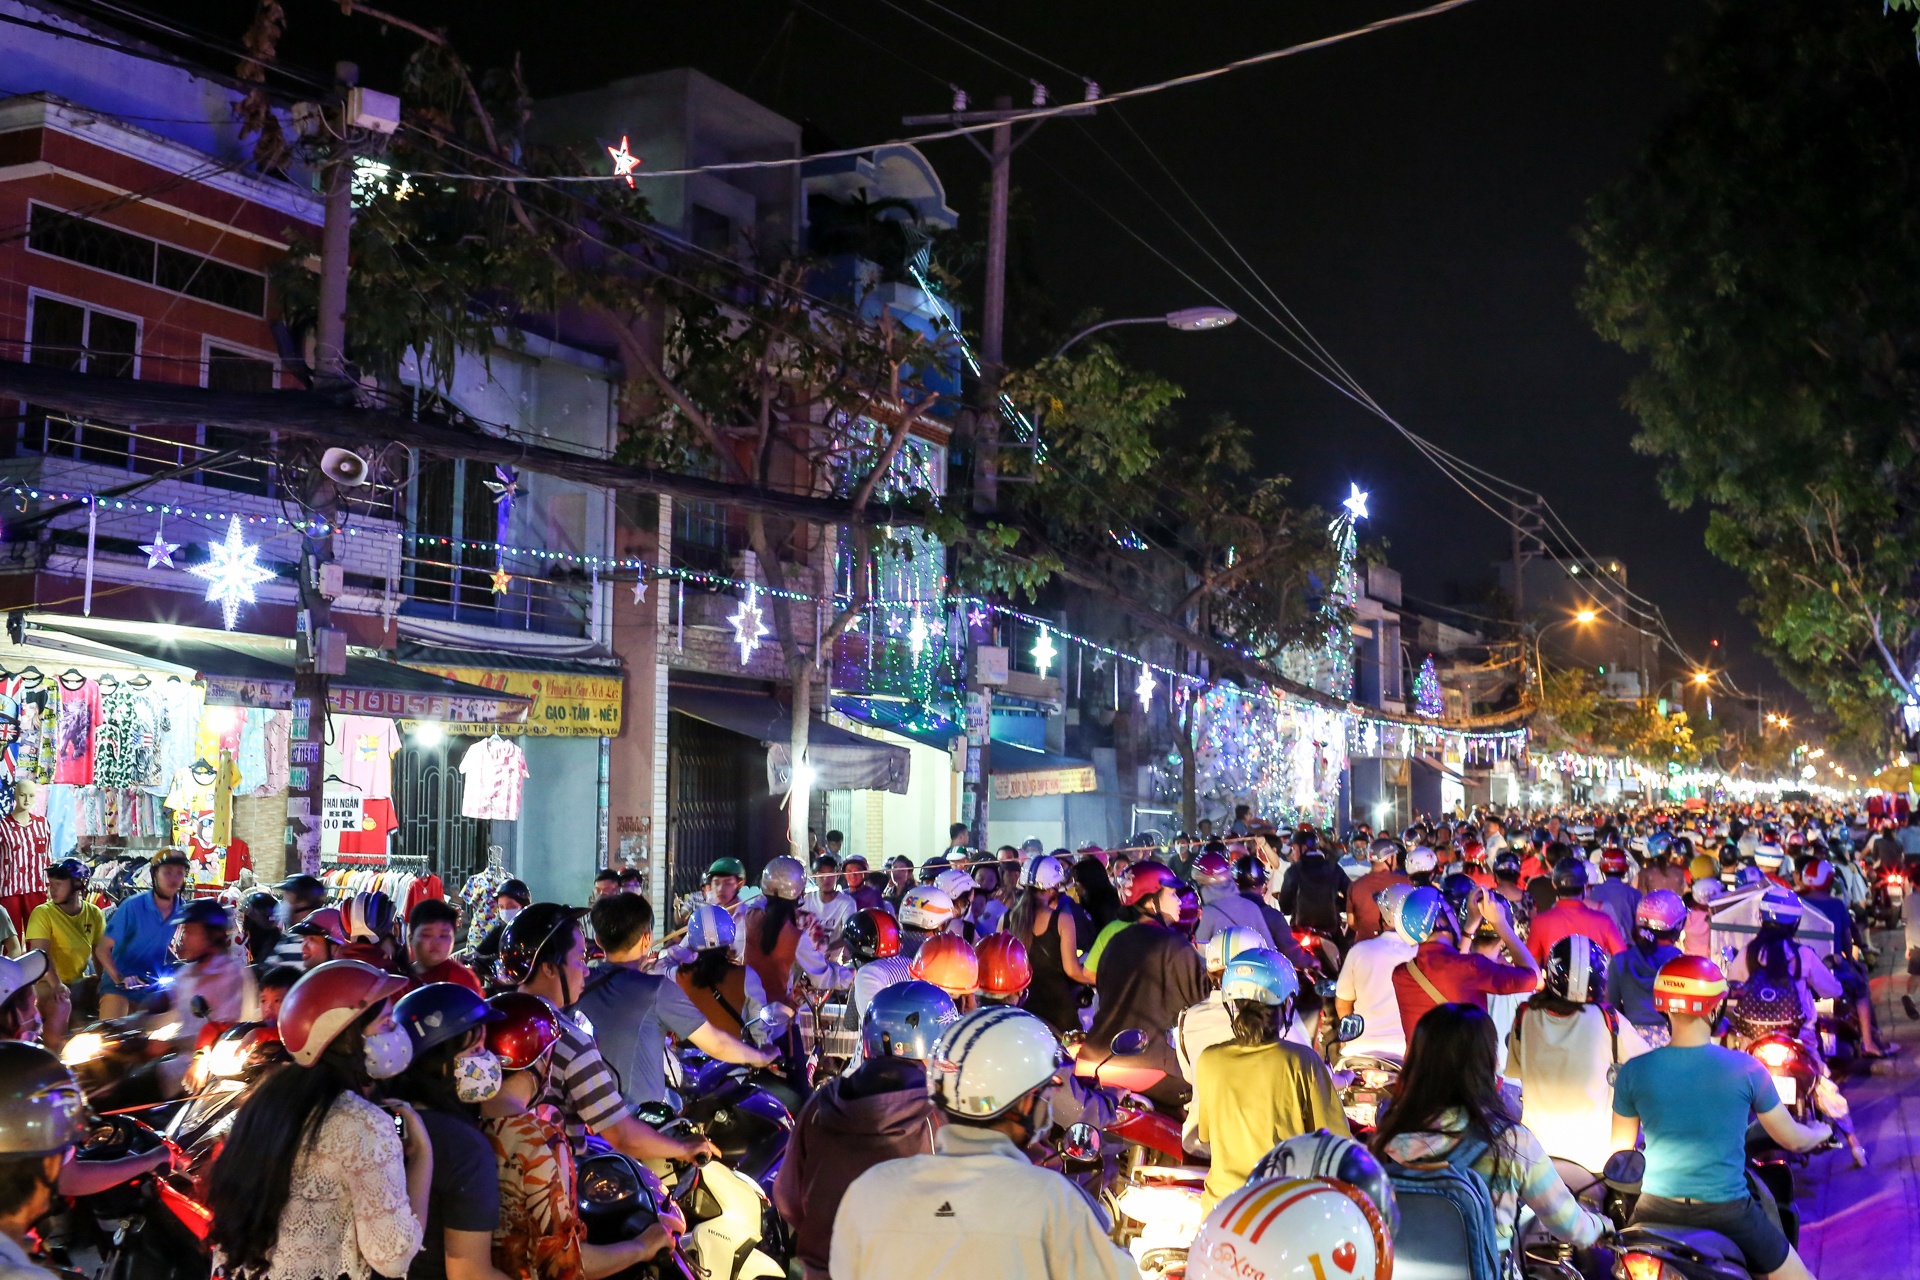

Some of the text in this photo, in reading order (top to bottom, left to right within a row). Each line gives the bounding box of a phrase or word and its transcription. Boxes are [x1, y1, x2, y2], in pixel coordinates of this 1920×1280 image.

[545, 705, 567, 723] GẠO
[323, 795, 359, 809] THÁI NGÂN
[1663, 980, 1685, 988] VEDAN
[707, 1228, 732, 1242] HONDA
